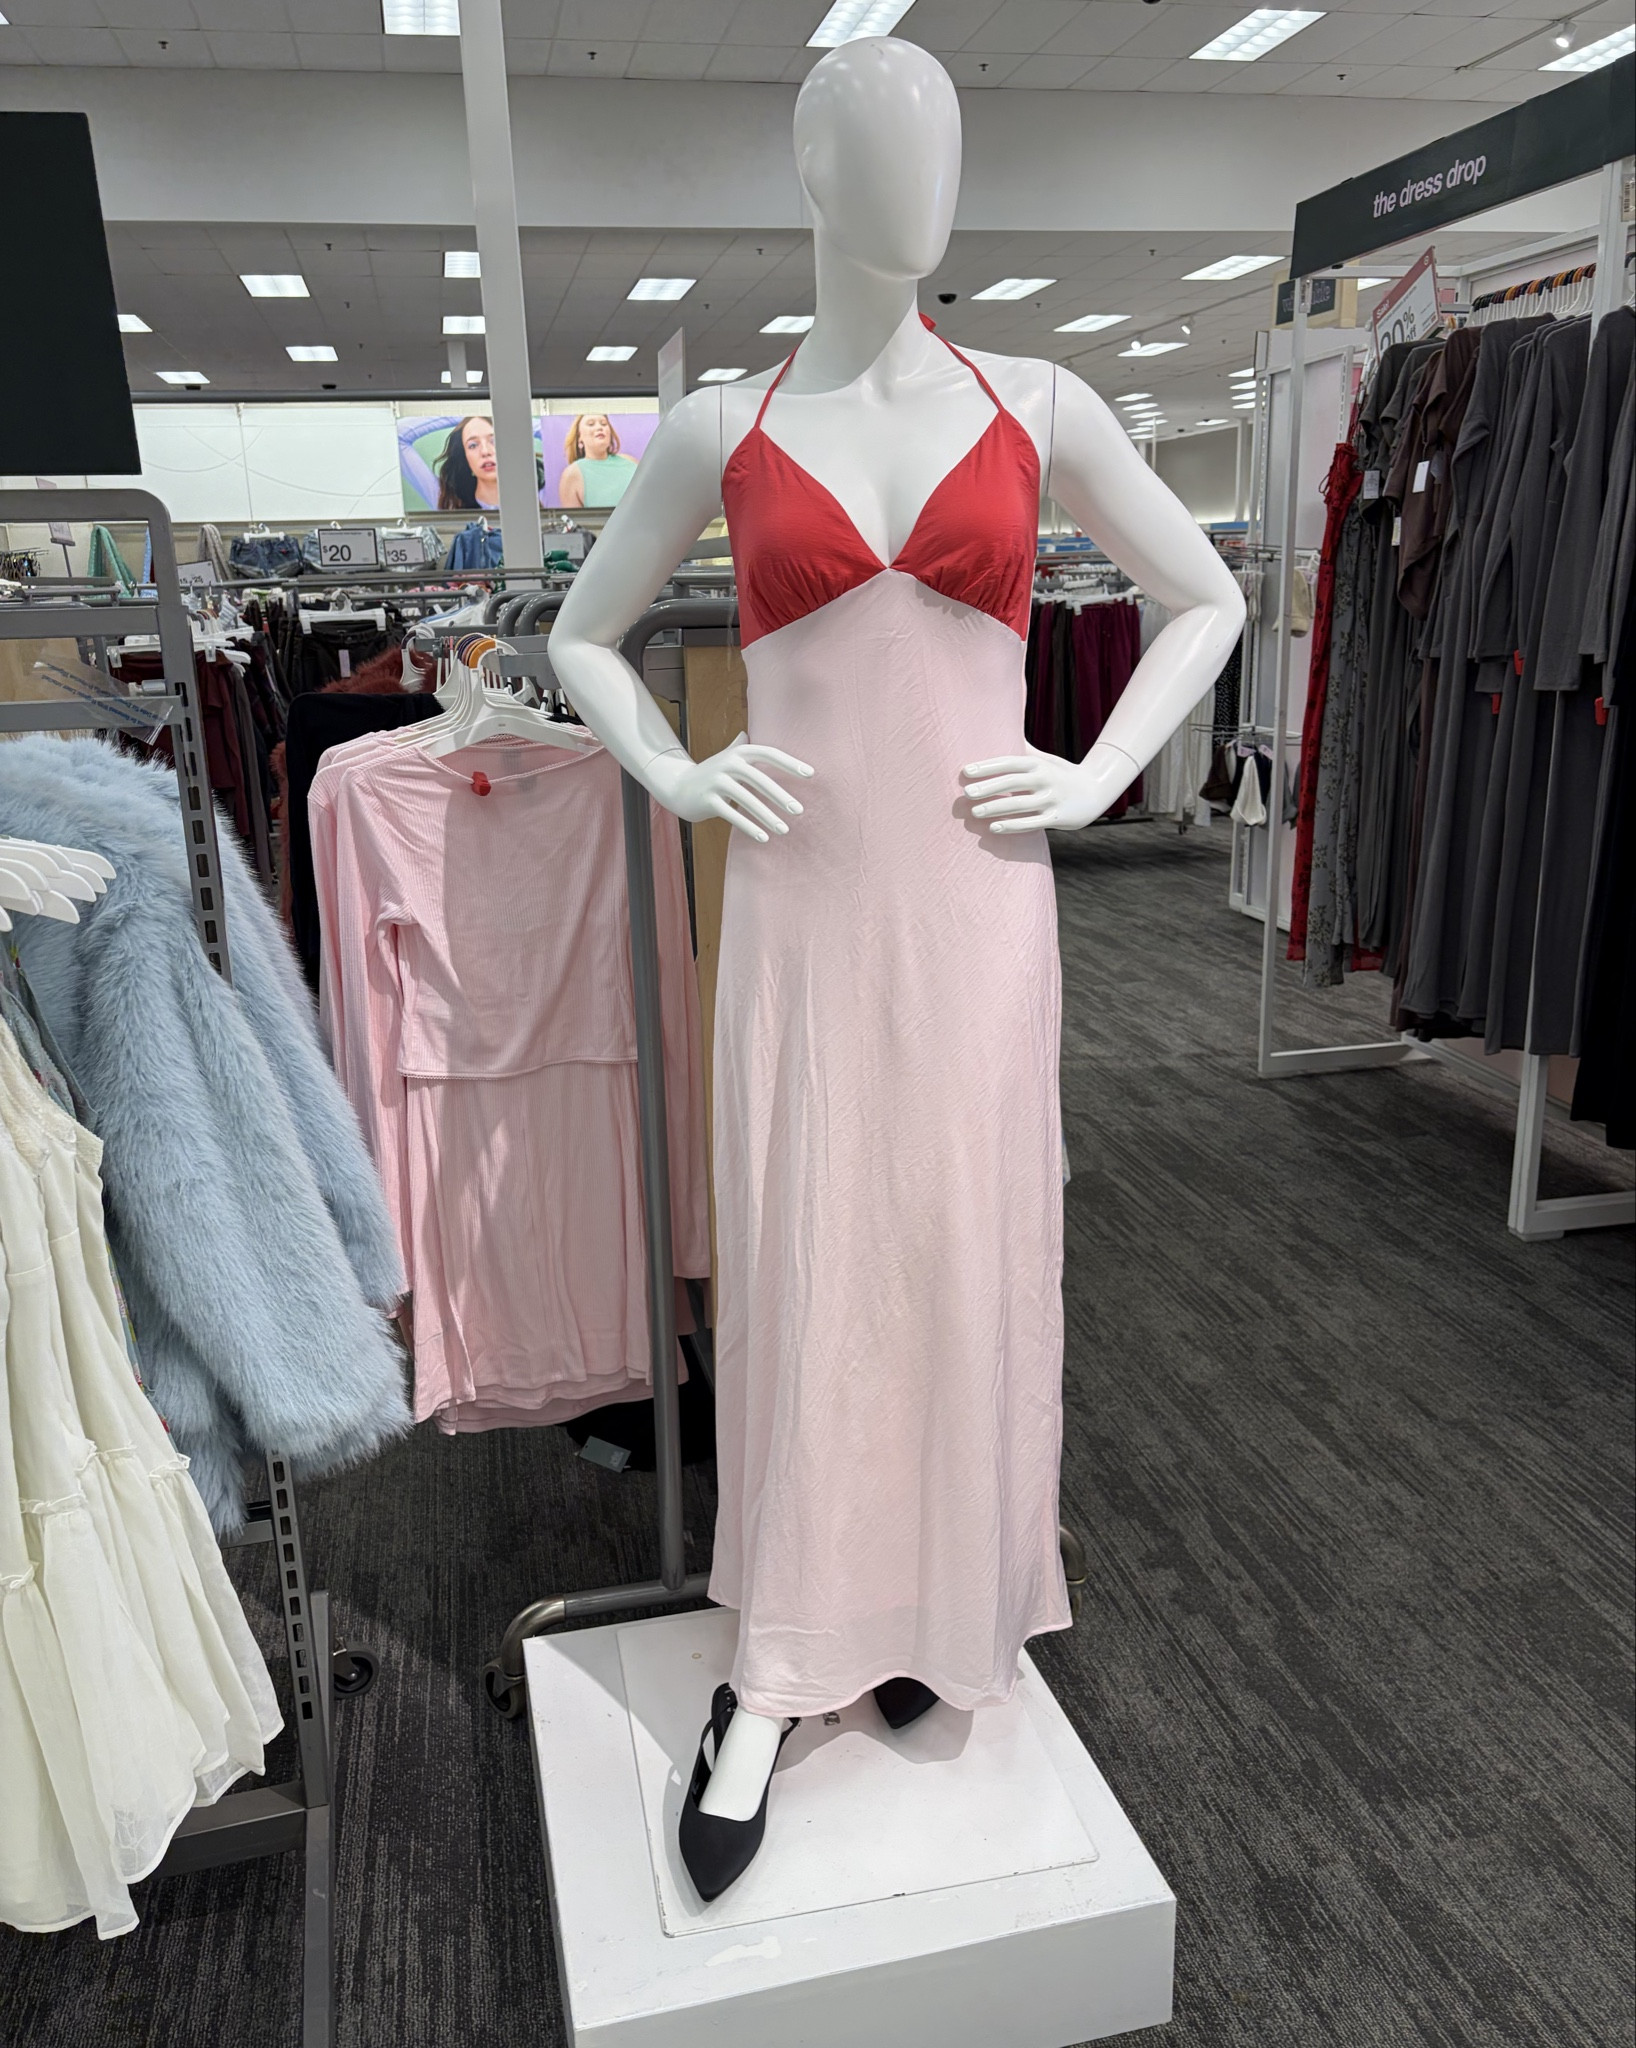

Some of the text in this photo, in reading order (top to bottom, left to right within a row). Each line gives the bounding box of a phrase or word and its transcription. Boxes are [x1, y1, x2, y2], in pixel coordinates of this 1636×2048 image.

[1373, 155, 1487, 218] the dress drop
[322, 544, 352, 562] $20
[386, 549, 408, 563] $35
